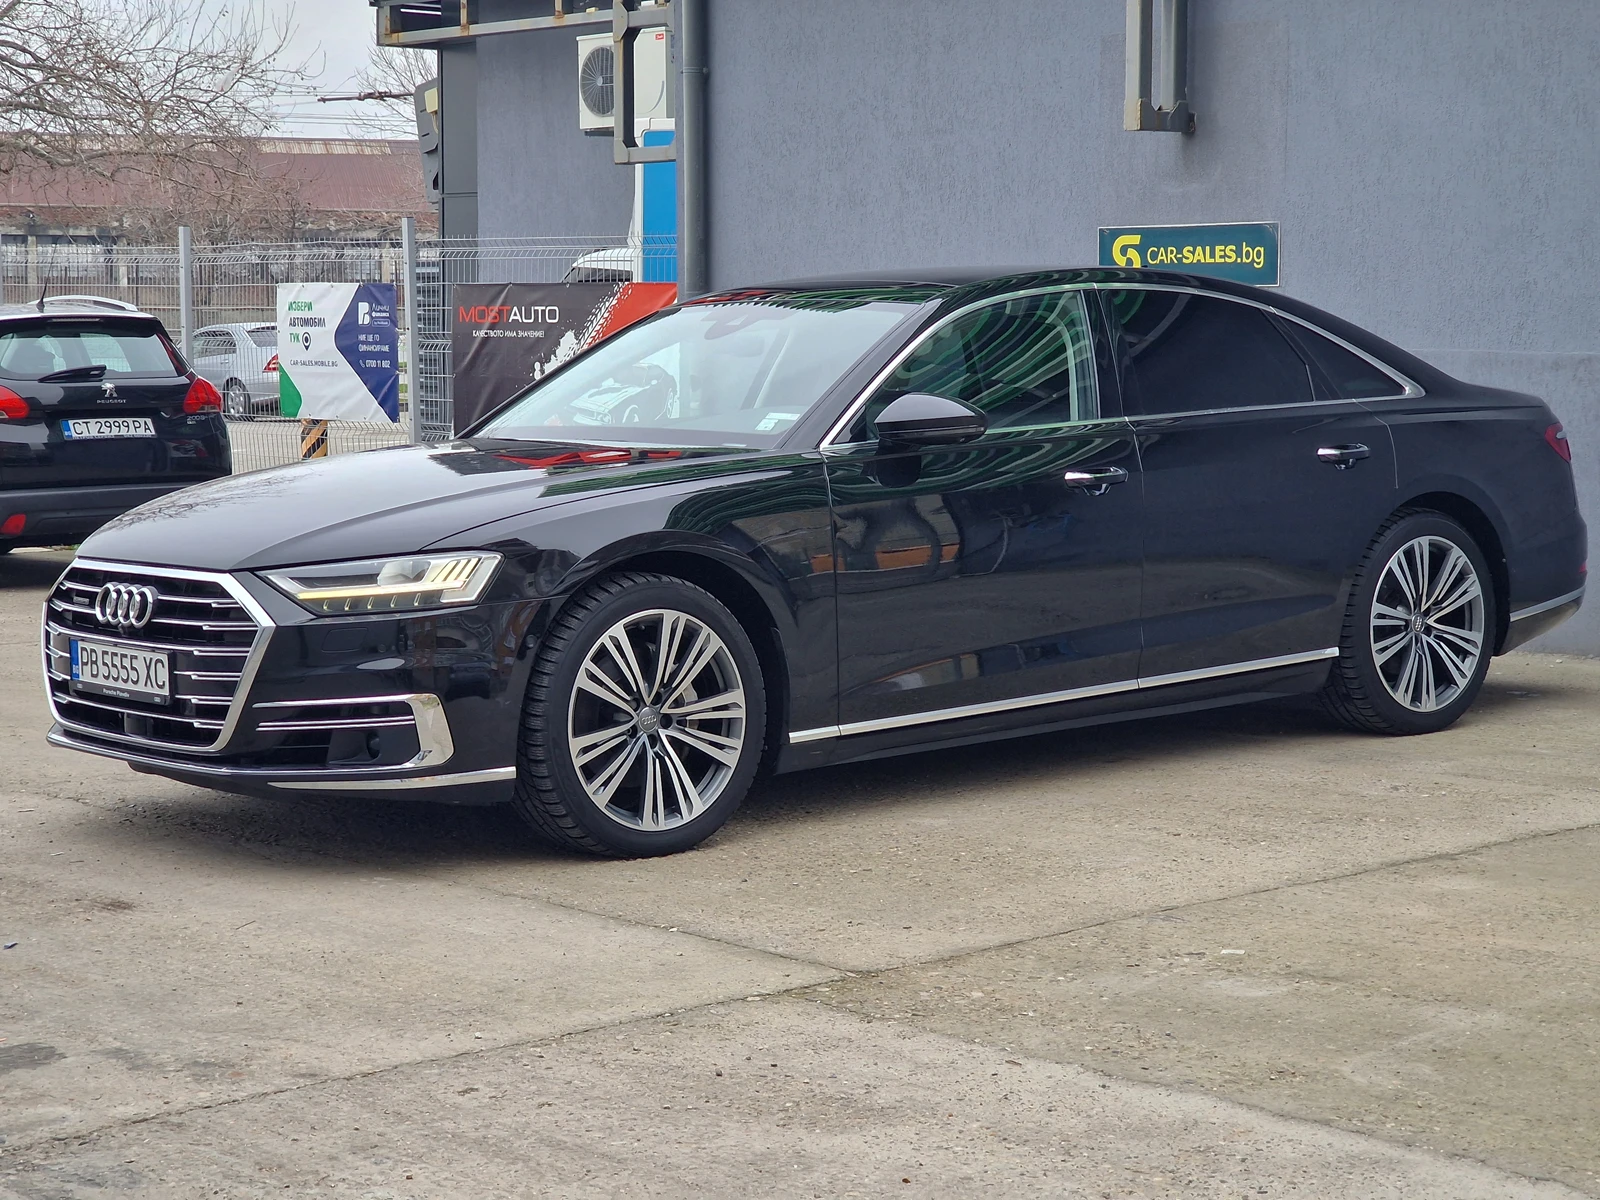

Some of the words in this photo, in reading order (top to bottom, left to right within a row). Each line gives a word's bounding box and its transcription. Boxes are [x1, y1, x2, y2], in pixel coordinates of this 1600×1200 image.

[1147, 242, 1265, 269] CAR-SALES.bg
[288, 301, 313, 311] ИЗБЕРИ
[458, 306, 559, 323] MOSTAUTO
[289, 317, 326, 327] АВТОМОБИЛ
[290, 333, 300, 342] ТУК
[472, 330, 504, 338] КАЧЕСТВОТО
[518, 330, 544, 338] ЗНАЧЕНИЕ!
[365, 359, 376, 368] 0700
[72, 421, 91, 435] CT
[95, 420, 130, 434] 2999
[80, 646, 99, 679] PB
[101, 650, 140, 685] 5555
[143, 656, 166, 690] XC
